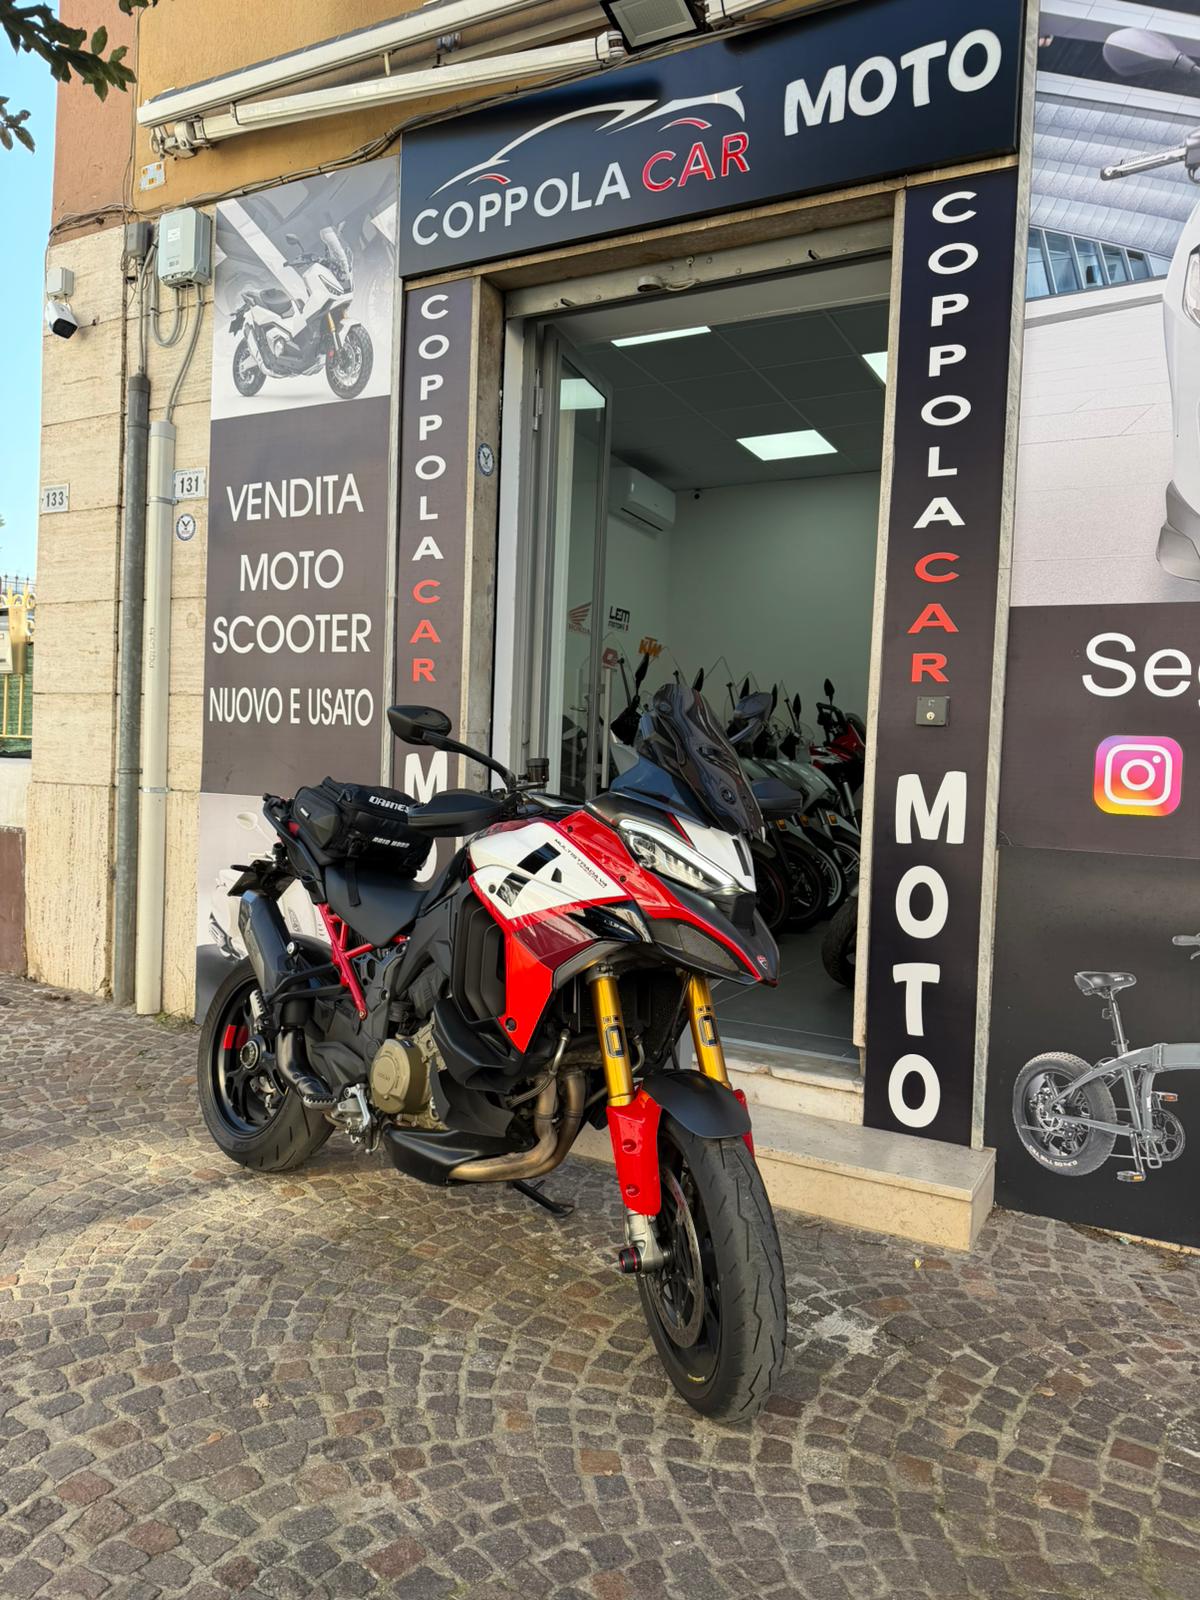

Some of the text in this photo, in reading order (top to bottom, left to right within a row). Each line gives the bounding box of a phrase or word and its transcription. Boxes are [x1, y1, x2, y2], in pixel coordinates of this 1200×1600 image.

[784, 29, 1002, 137] MOTO
[411, 133, 750, 247] COPPOLA CAR
[907, 190, 980, 685] COPPOLA CAR
[46, 491, 65, 507] 133
[180, 475, 199, 494] 131
[225, 472, 365, 522] VENDITA
[409, 292, 450, 684] COPPOLA CAR
[239, 548, 345, 592] MOTO
[211, 613, 372, 654] SCOOTER
[1081, 632, 1200, 709] Se
[209, 686, 374, 727] NUOVO E USATO
[368, 795, 411, 814] DAINES
[888, 770, 967, 1129] MOTO
